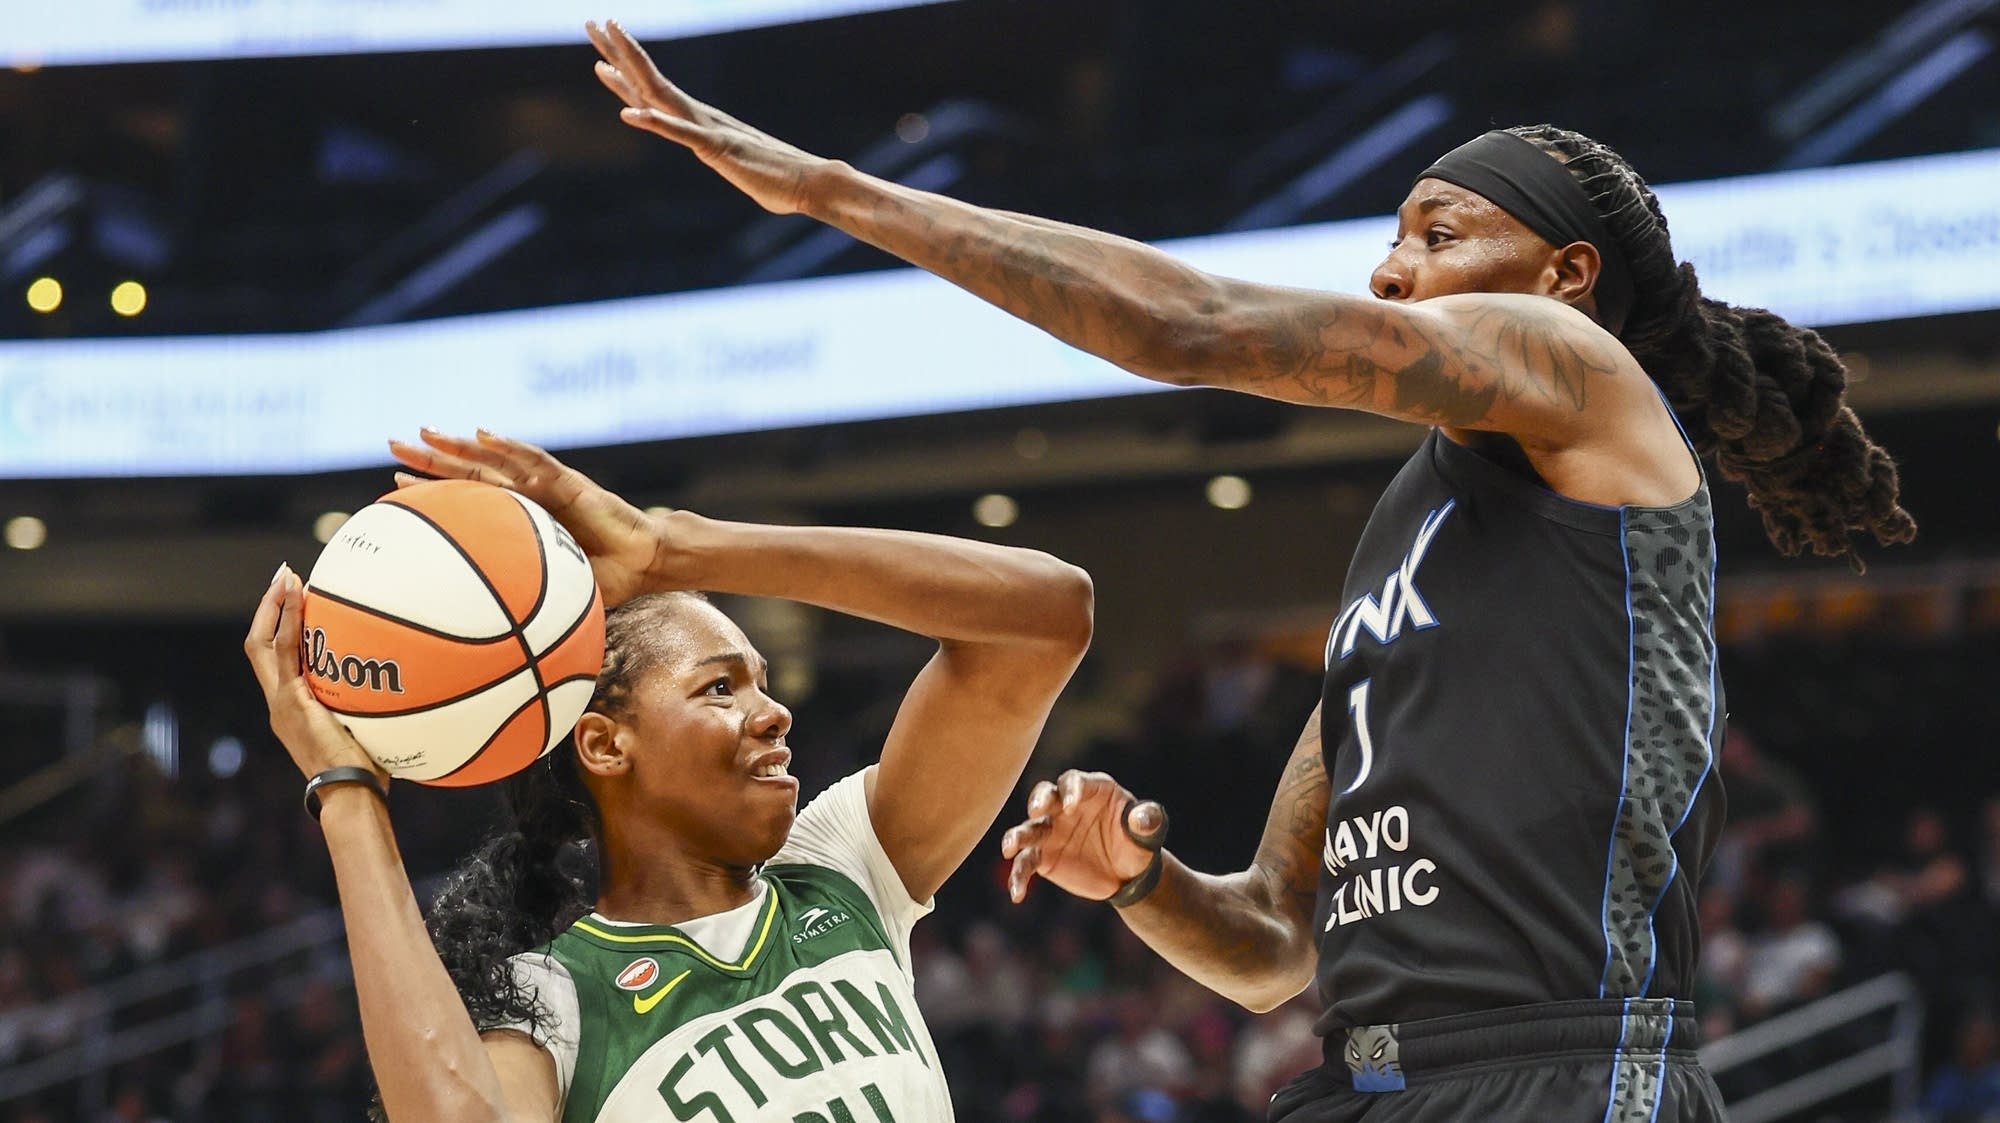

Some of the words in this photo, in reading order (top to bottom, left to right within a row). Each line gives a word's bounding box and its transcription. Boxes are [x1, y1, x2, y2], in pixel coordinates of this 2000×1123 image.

[304, 626, 405, 694] ilson
[1340, 676, 1373, 796] 1
[1324, 805, 1409, 877] MAYO
[792, 911, 851, 944] SYMETRA
[657, 978, 931, 1123] STORM
